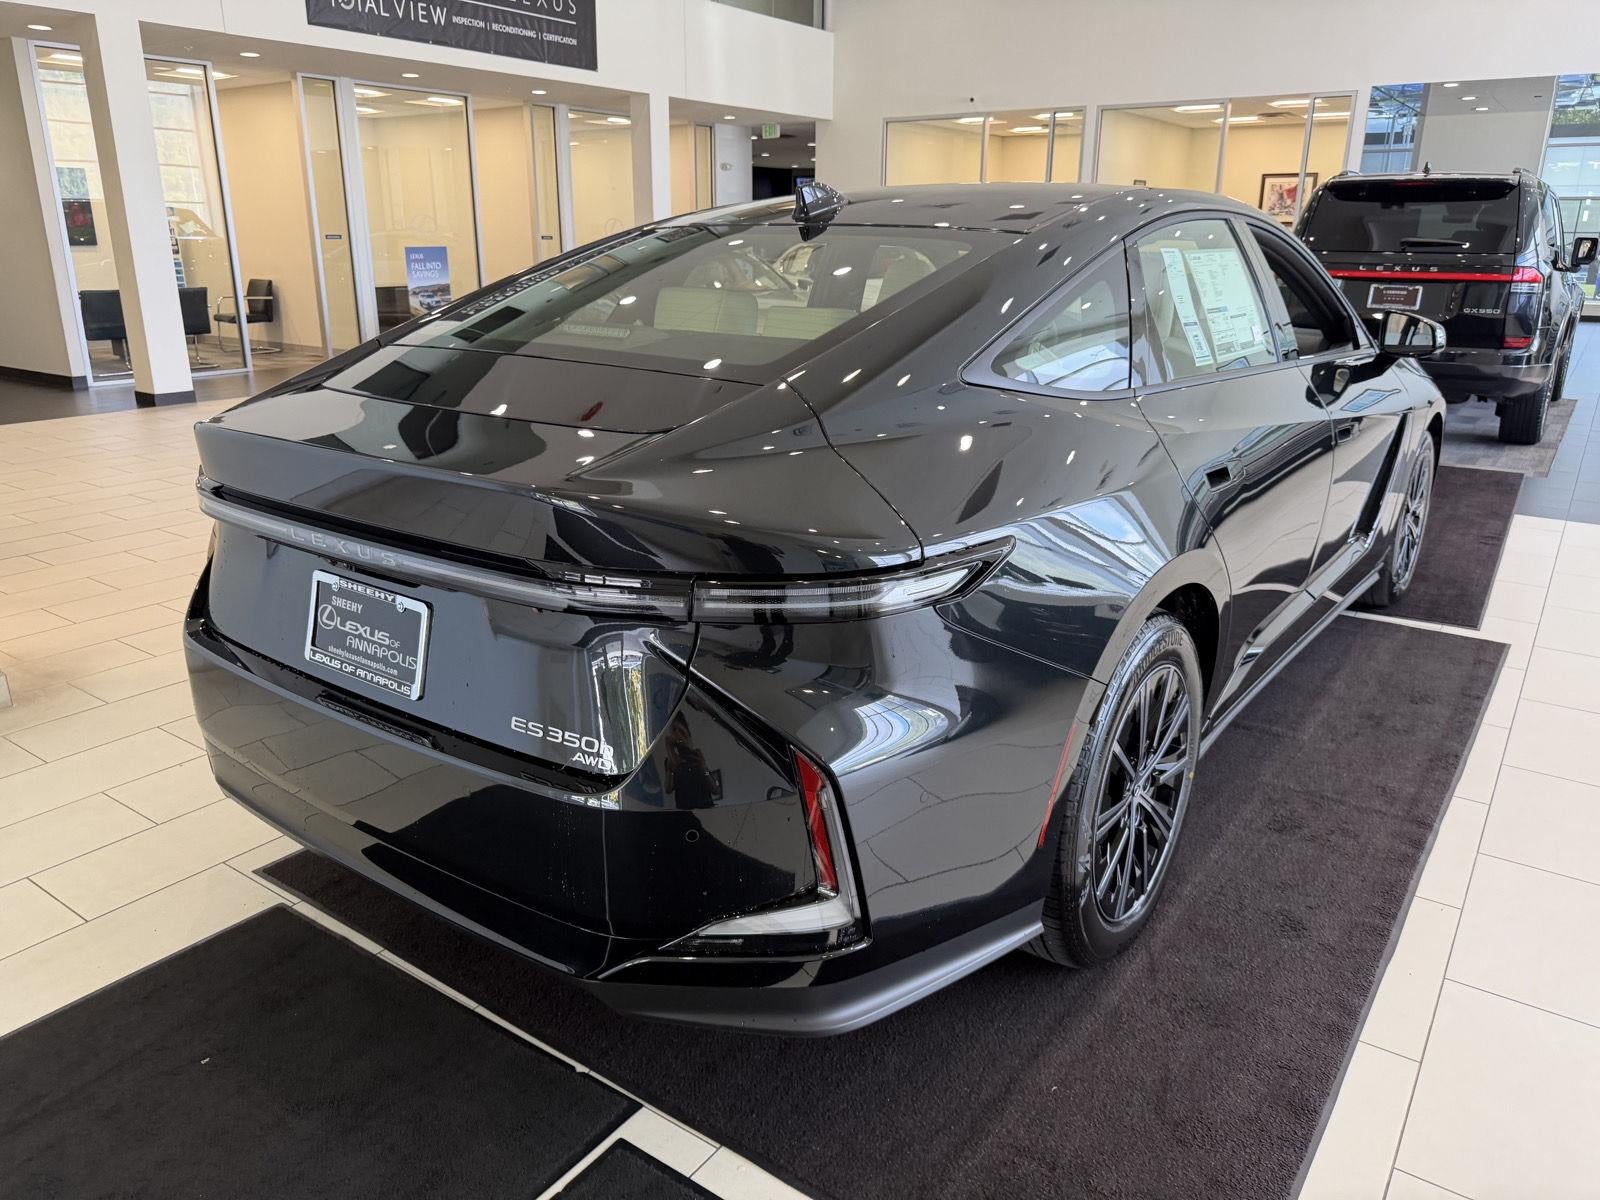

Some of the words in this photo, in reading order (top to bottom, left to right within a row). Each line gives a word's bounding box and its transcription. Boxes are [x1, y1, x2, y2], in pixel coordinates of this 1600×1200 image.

[394, 0, 447, 26] VIEW
[452, 15, 485, 29] INSPECTION
[492, 23, 537, 38] RECONDITIONING
[543, 33, 578, 46] CERTIFICATION
[411, 262, 426, 271] FALL
[412, 270, 440, 279] SAVINGS
[1463, 307, 1501, 315] GX550
[290, 527, 396, 567] LEXUS
[338, 579, 395, 603] SHEEHY
[331, 595, 363, 614] SHEEHY
[337, 616, 390, 645] LEXUS
[389, 639, 401, 649] OF
[346, 635, 417, 670] ANNAPOLIS
[310, 650, 341, 669] LEXUS
[342, 663, 355, 674] OF
[356, 667, 411, 696] ANNAPOLIS
[572, 752, 612, 771] AWD
